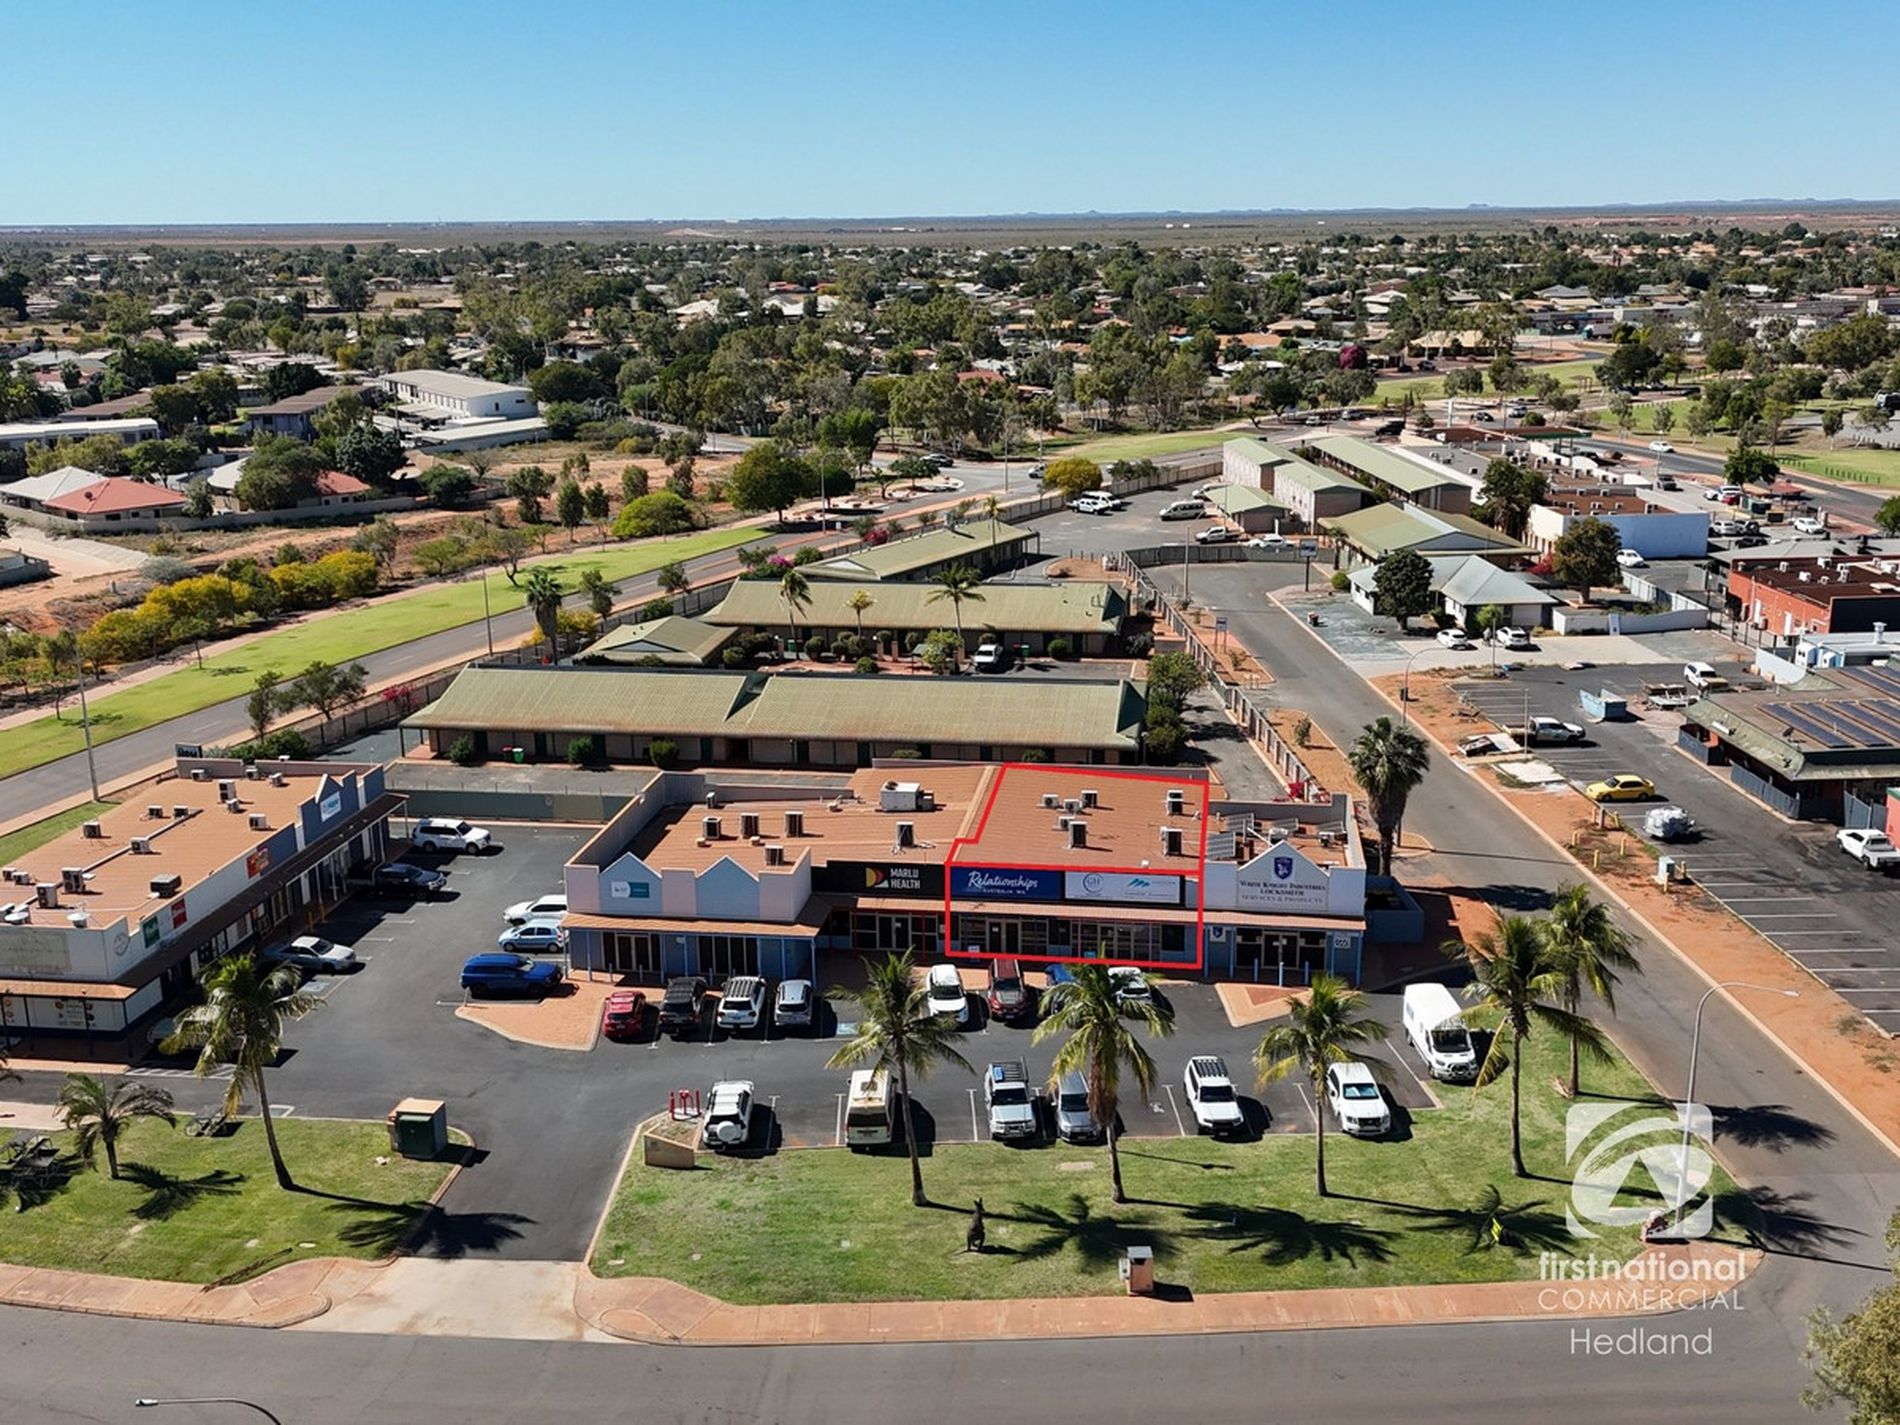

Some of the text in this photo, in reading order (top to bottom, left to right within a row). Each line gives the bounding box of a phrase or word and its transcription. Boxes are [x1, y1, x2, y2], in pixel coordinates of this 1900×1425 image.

[891, 868, 919, 878] MARLU
[890, 878, 920, 889] HEALTH
[968, 871, 1038, 891] Relationships
